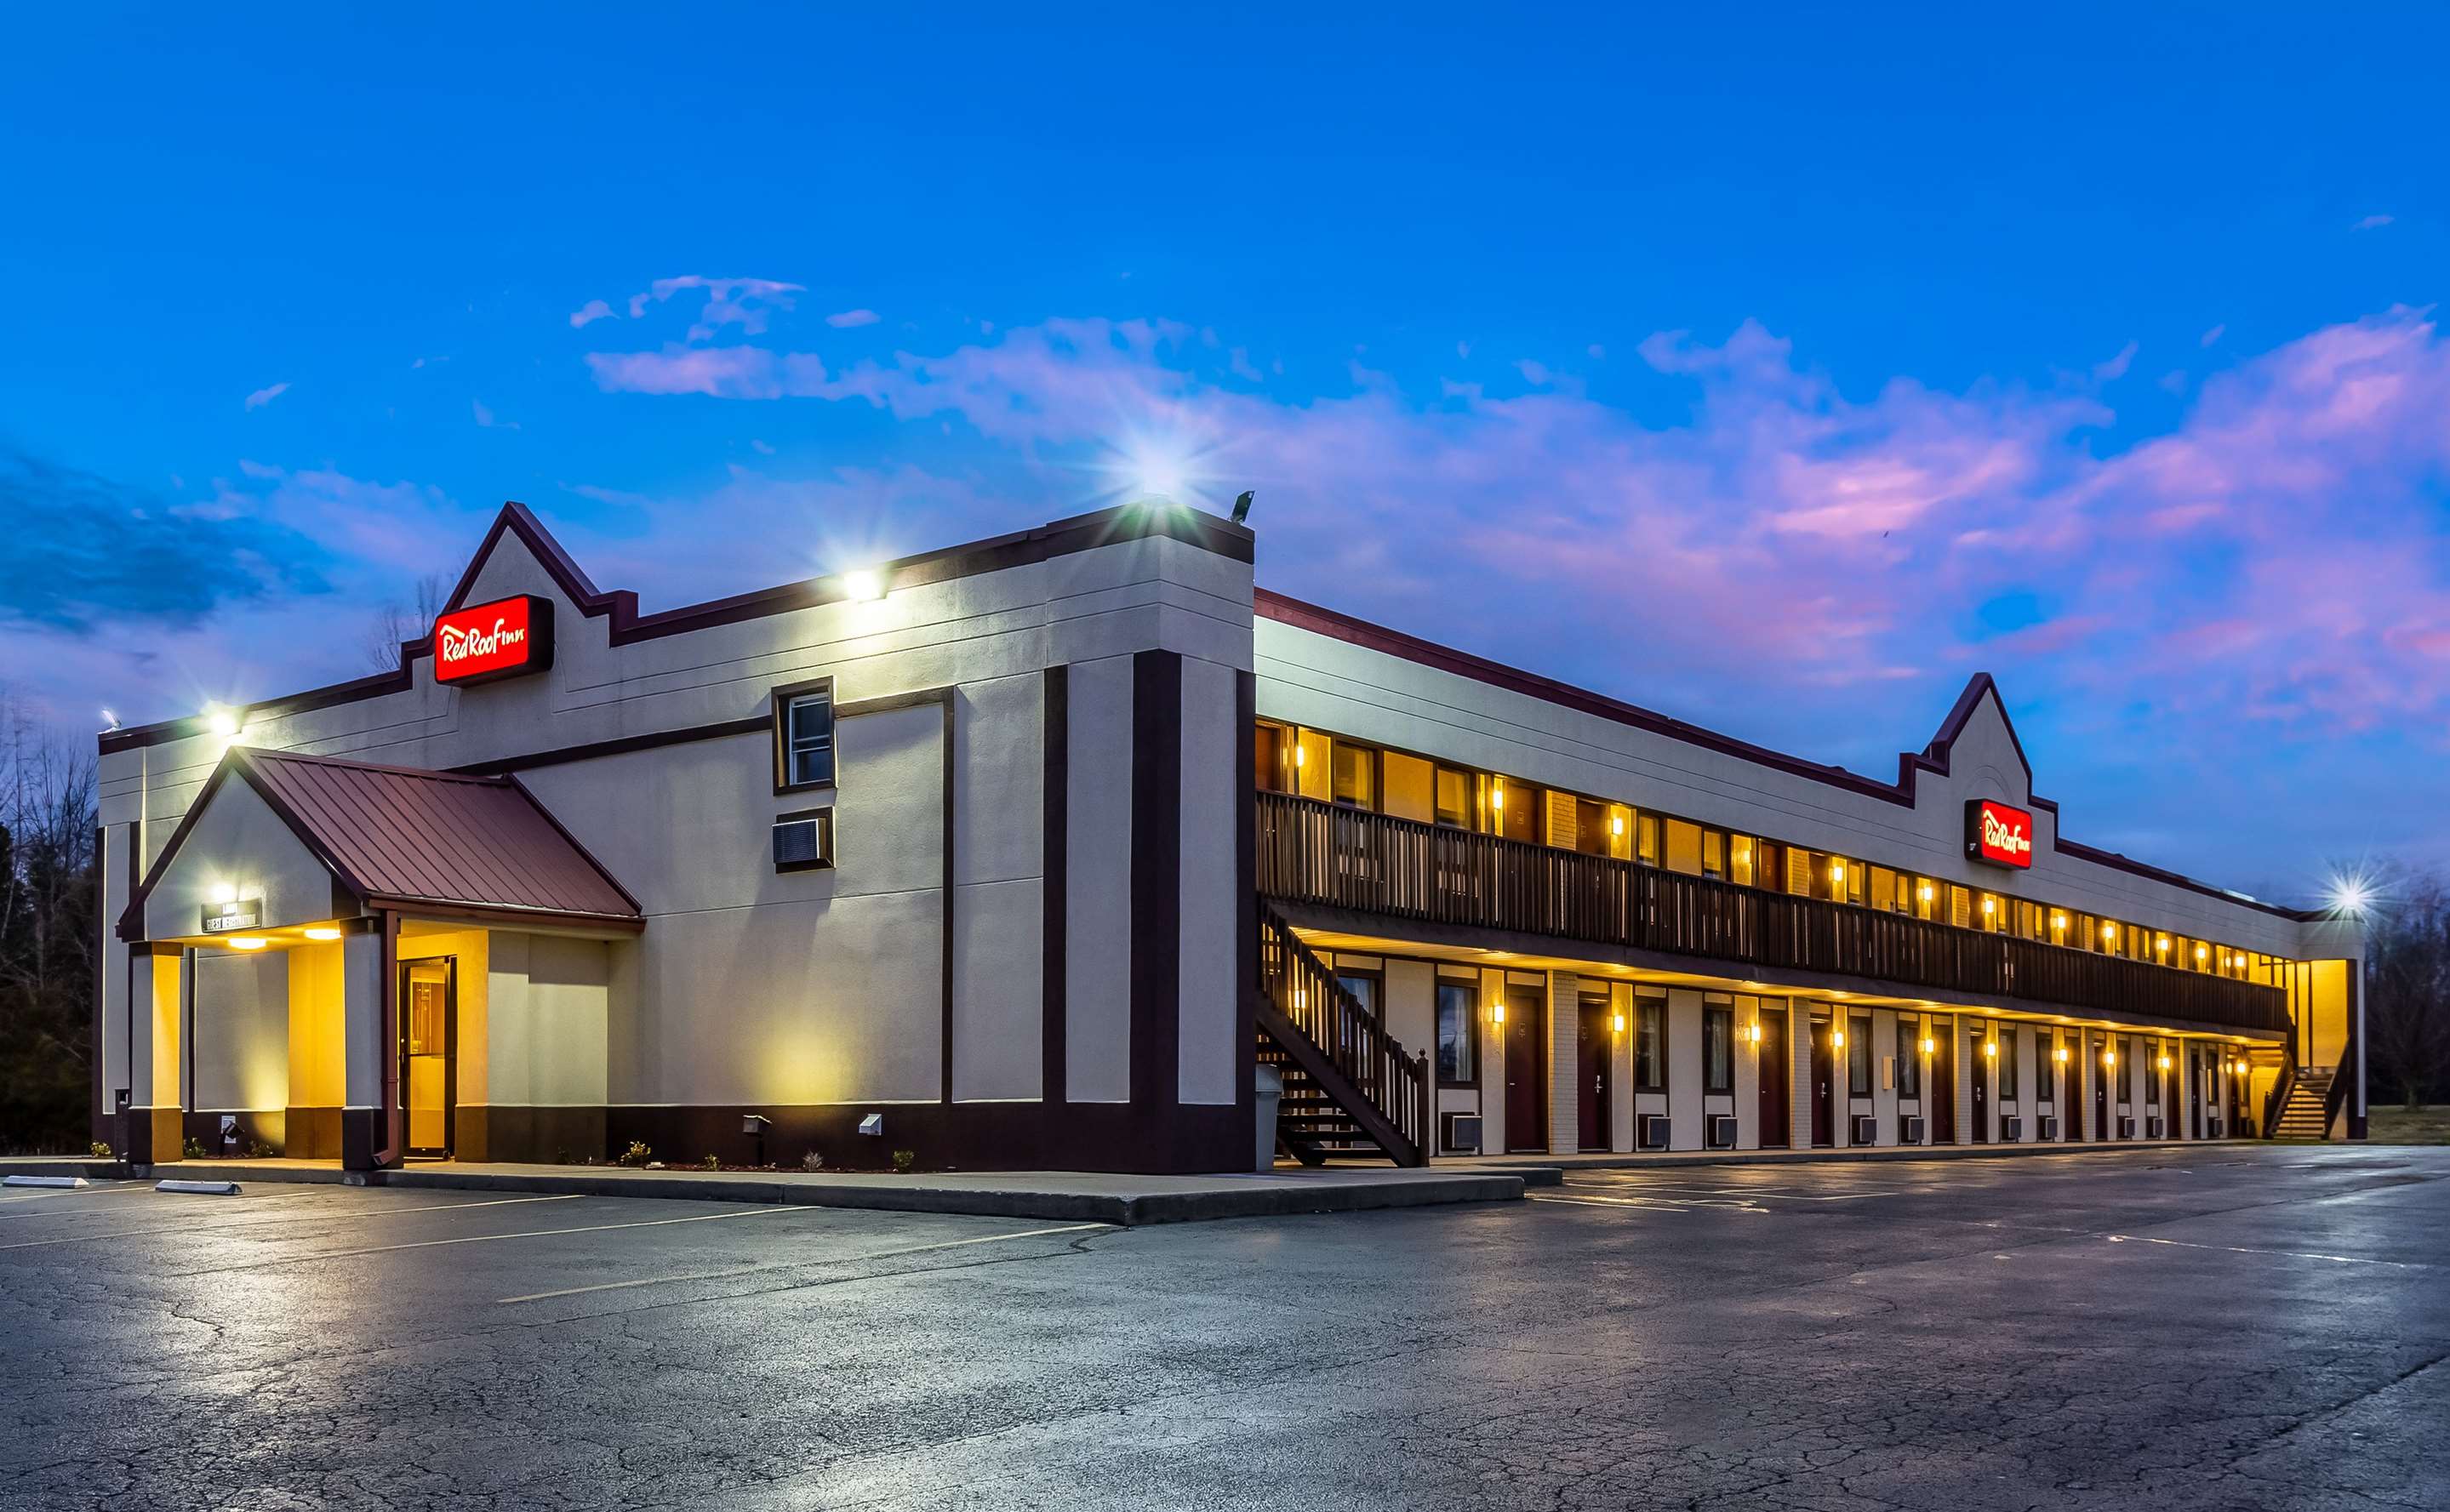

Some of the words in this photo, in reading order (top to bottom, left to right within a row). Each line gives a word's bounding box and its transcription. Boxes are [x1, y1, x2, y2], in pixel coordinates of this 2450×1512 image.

[443, 634, 469, 662] Red
[469, 619, 504, 656] Roof
[501, 628, 525, 646] Inn
[1985, 819, 2001, 847] Red
[2001, 824, 2021, 854] Roof
